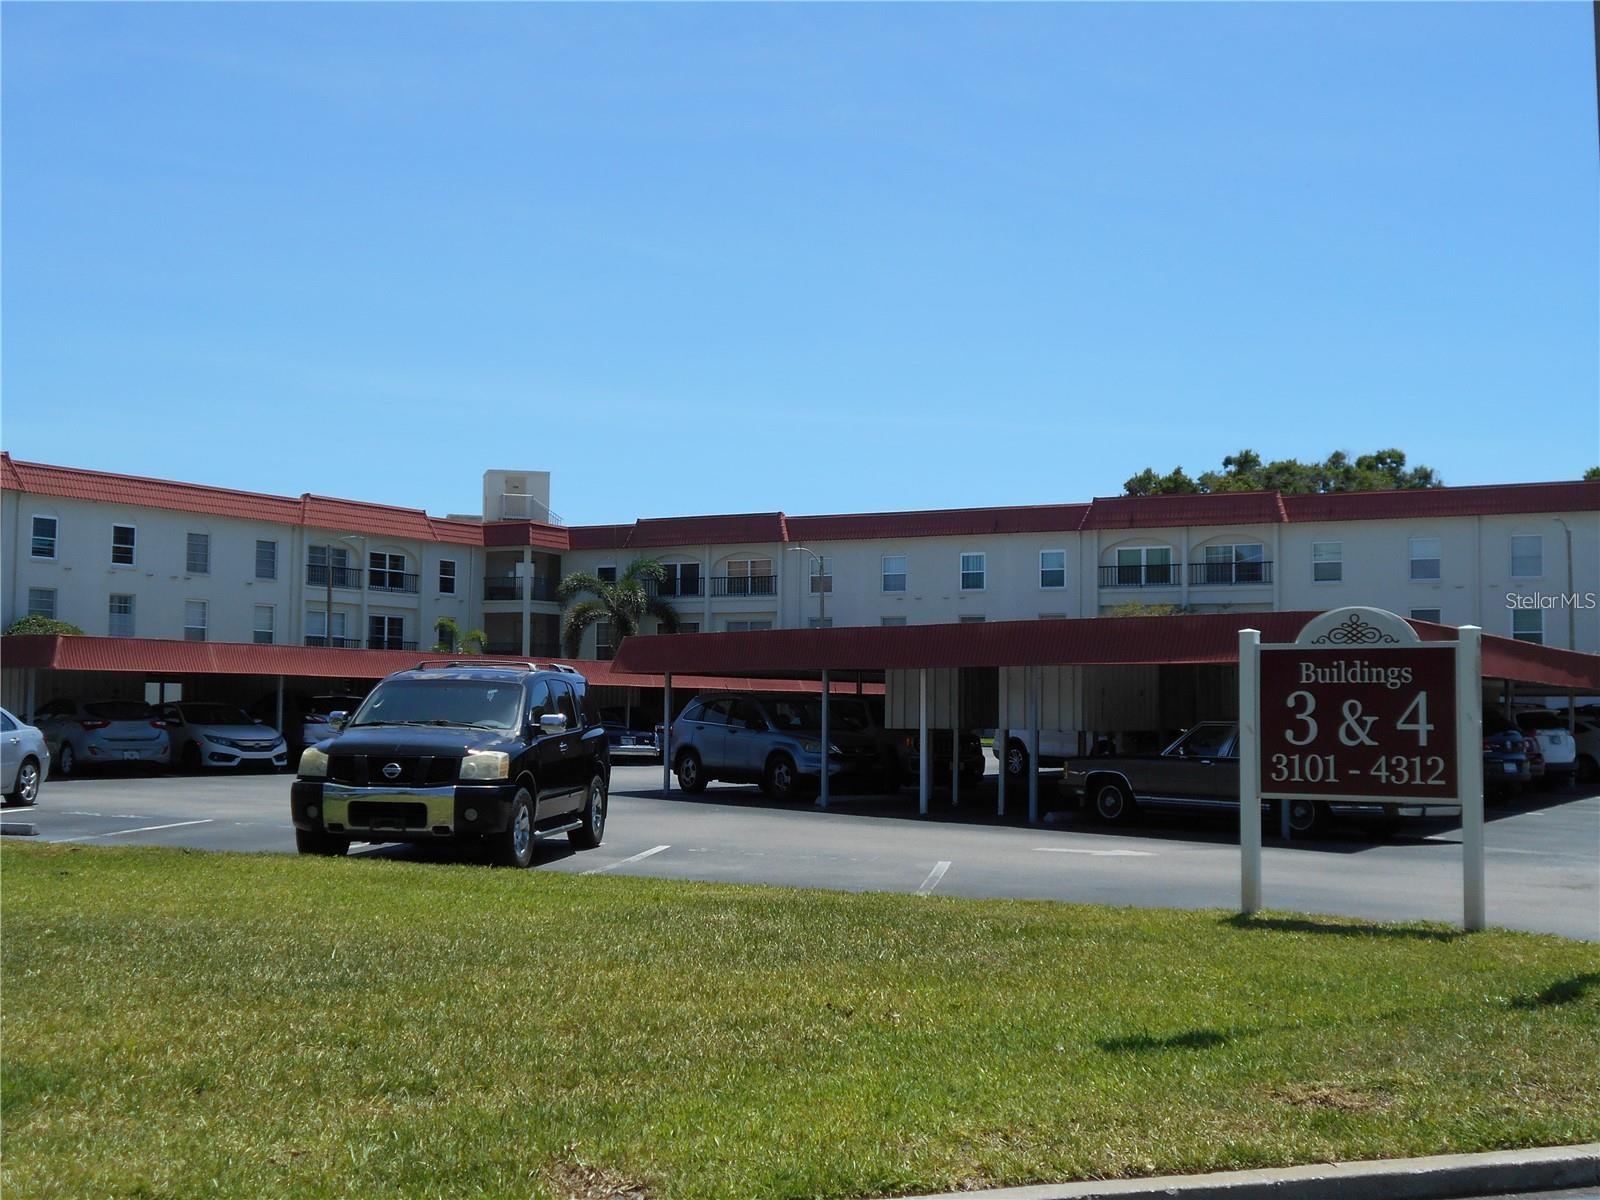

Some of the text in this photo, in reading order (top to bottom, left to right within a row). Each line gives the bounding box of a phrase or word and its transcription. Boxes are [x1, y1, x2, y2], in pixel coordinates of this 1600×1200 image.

[1300, 660, 1413, 689] Buildings
[1284, 691, 1434, 746] 3 & 4
[1271, 754, 1339, 782] 3101
[1370, 756, 1446, 785] 4312
